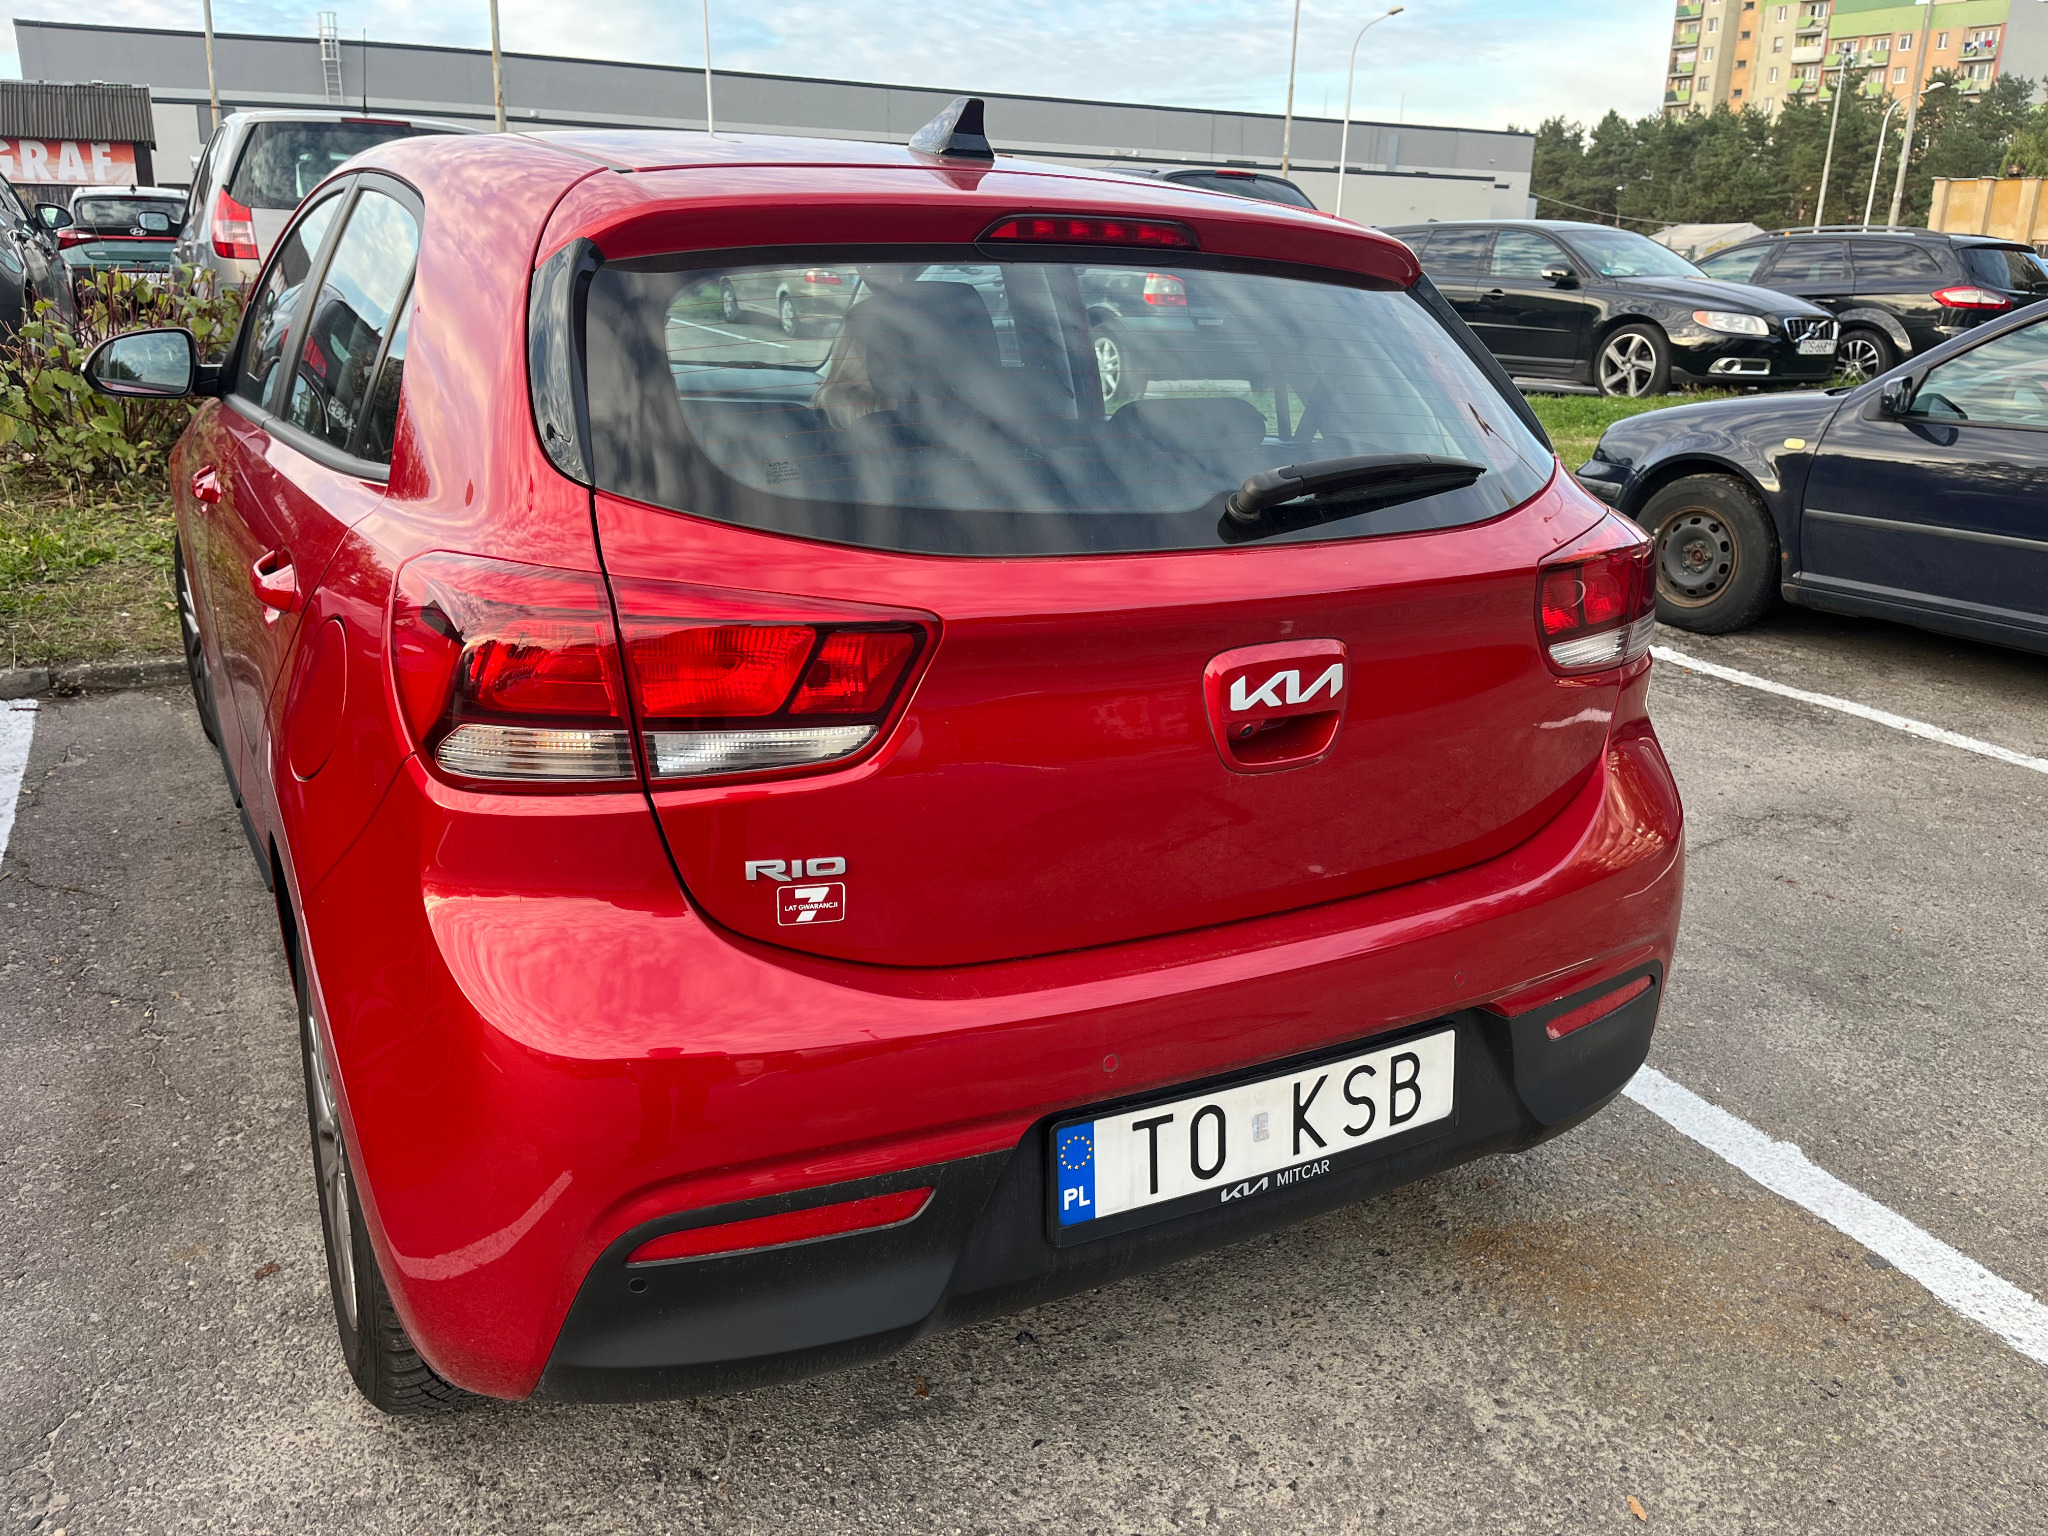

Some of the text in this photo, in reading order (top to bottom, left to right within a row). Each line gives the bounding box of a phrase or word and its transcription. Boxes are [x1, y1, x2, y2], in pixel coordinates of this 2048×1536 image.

[1230, 662, 1343, 711] KIA
[745, 856, 846, 882] RIO
[784, 901, 838, 912] LAT GWARANCJI
[794, 886, 830, 922] 7
[1292, 1051, 1422, 1156] KSB
[1063, 1186, 1091, 1211] PL
[1220, 1159, 1330, 1203] KIA MITCAR
